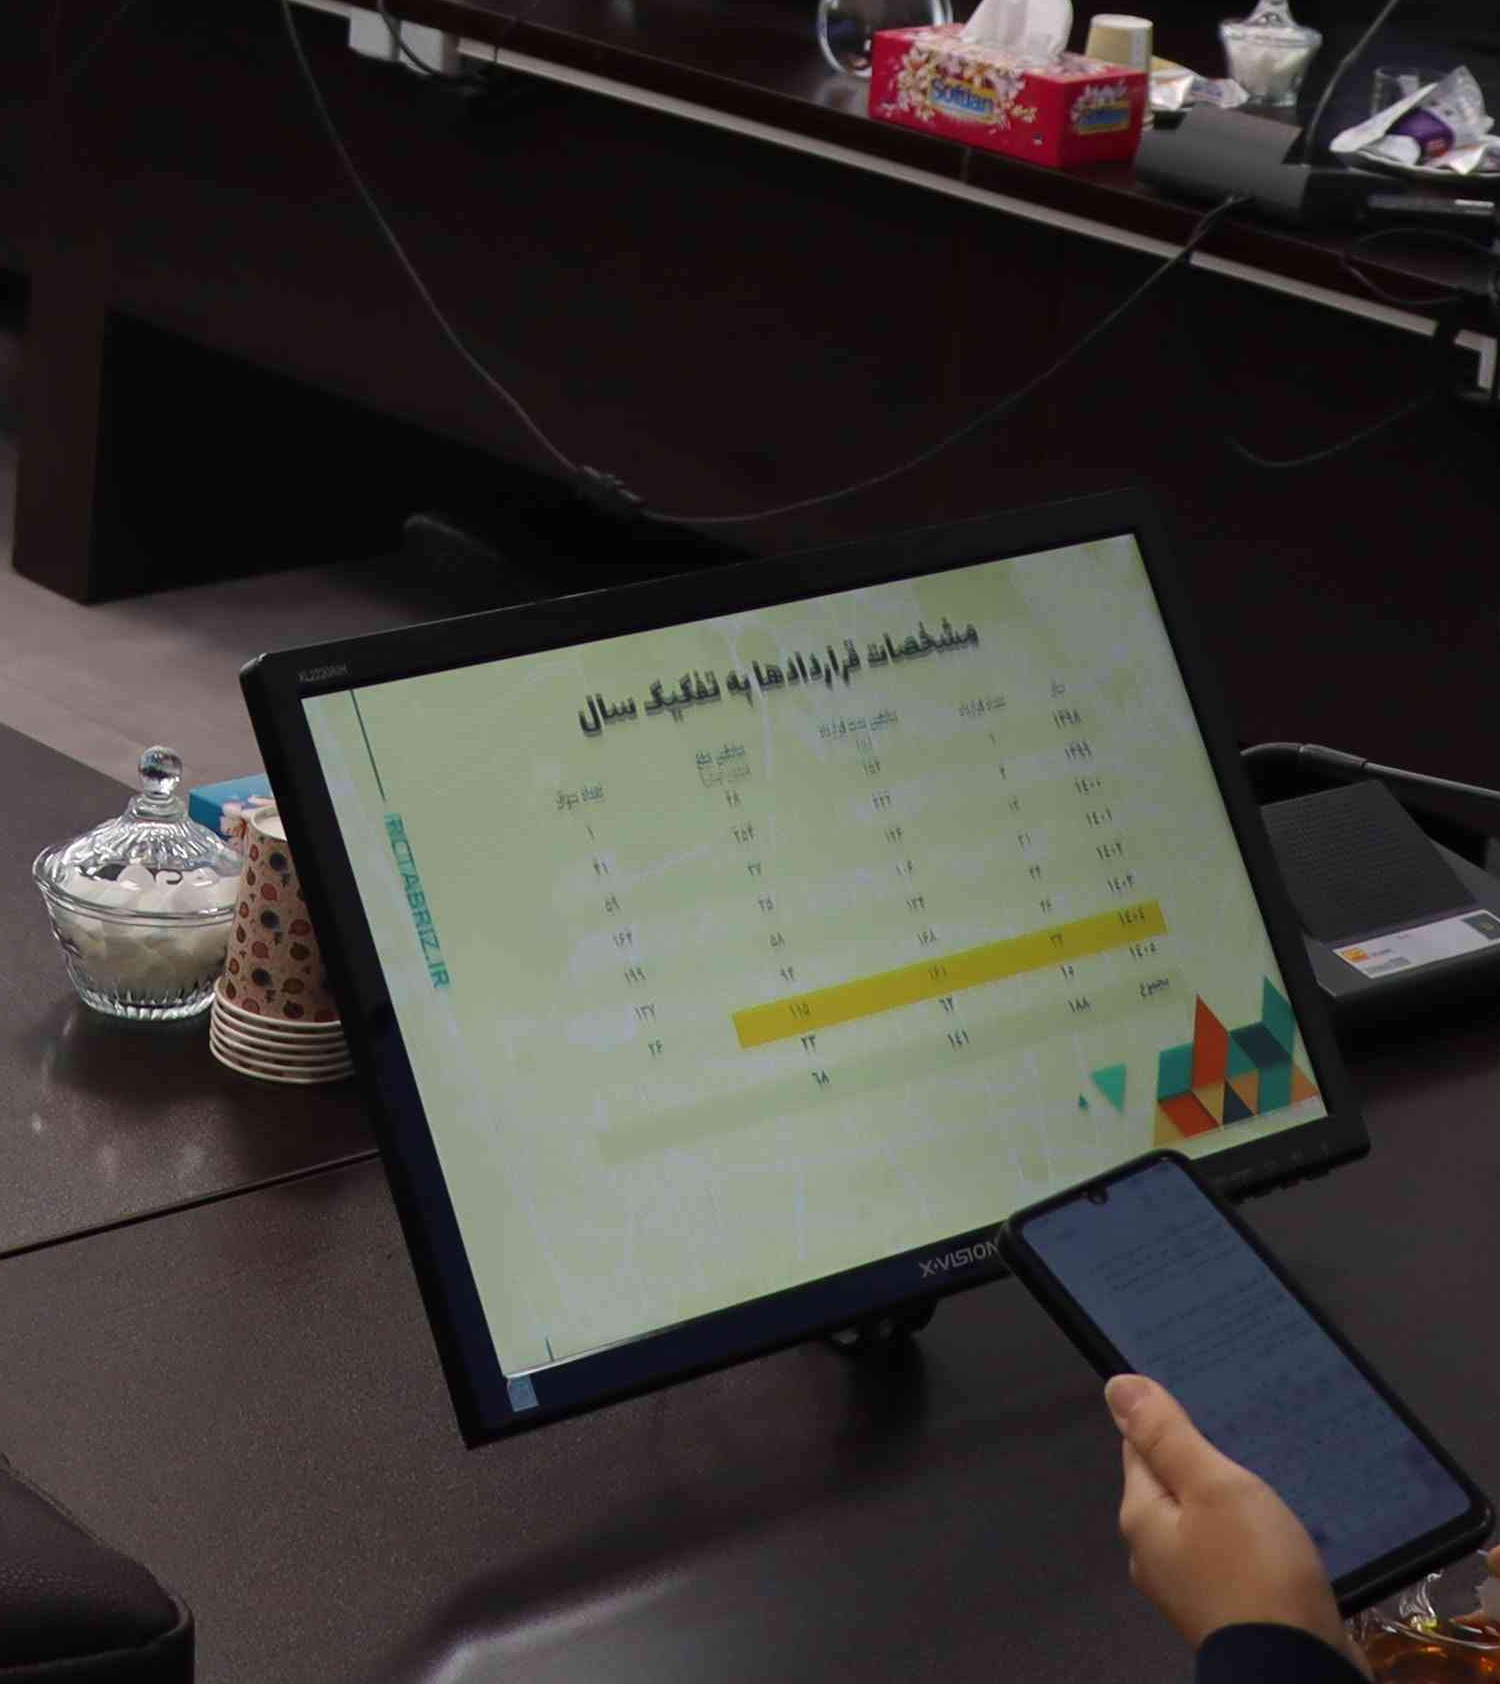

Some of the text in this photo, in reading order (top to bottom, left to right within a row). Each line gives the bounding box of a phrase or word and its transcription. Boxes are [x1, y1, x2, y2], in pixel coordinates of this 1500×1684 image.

[577, 616, 980, 738] مشخصات قراردادها به تفکیک سال
